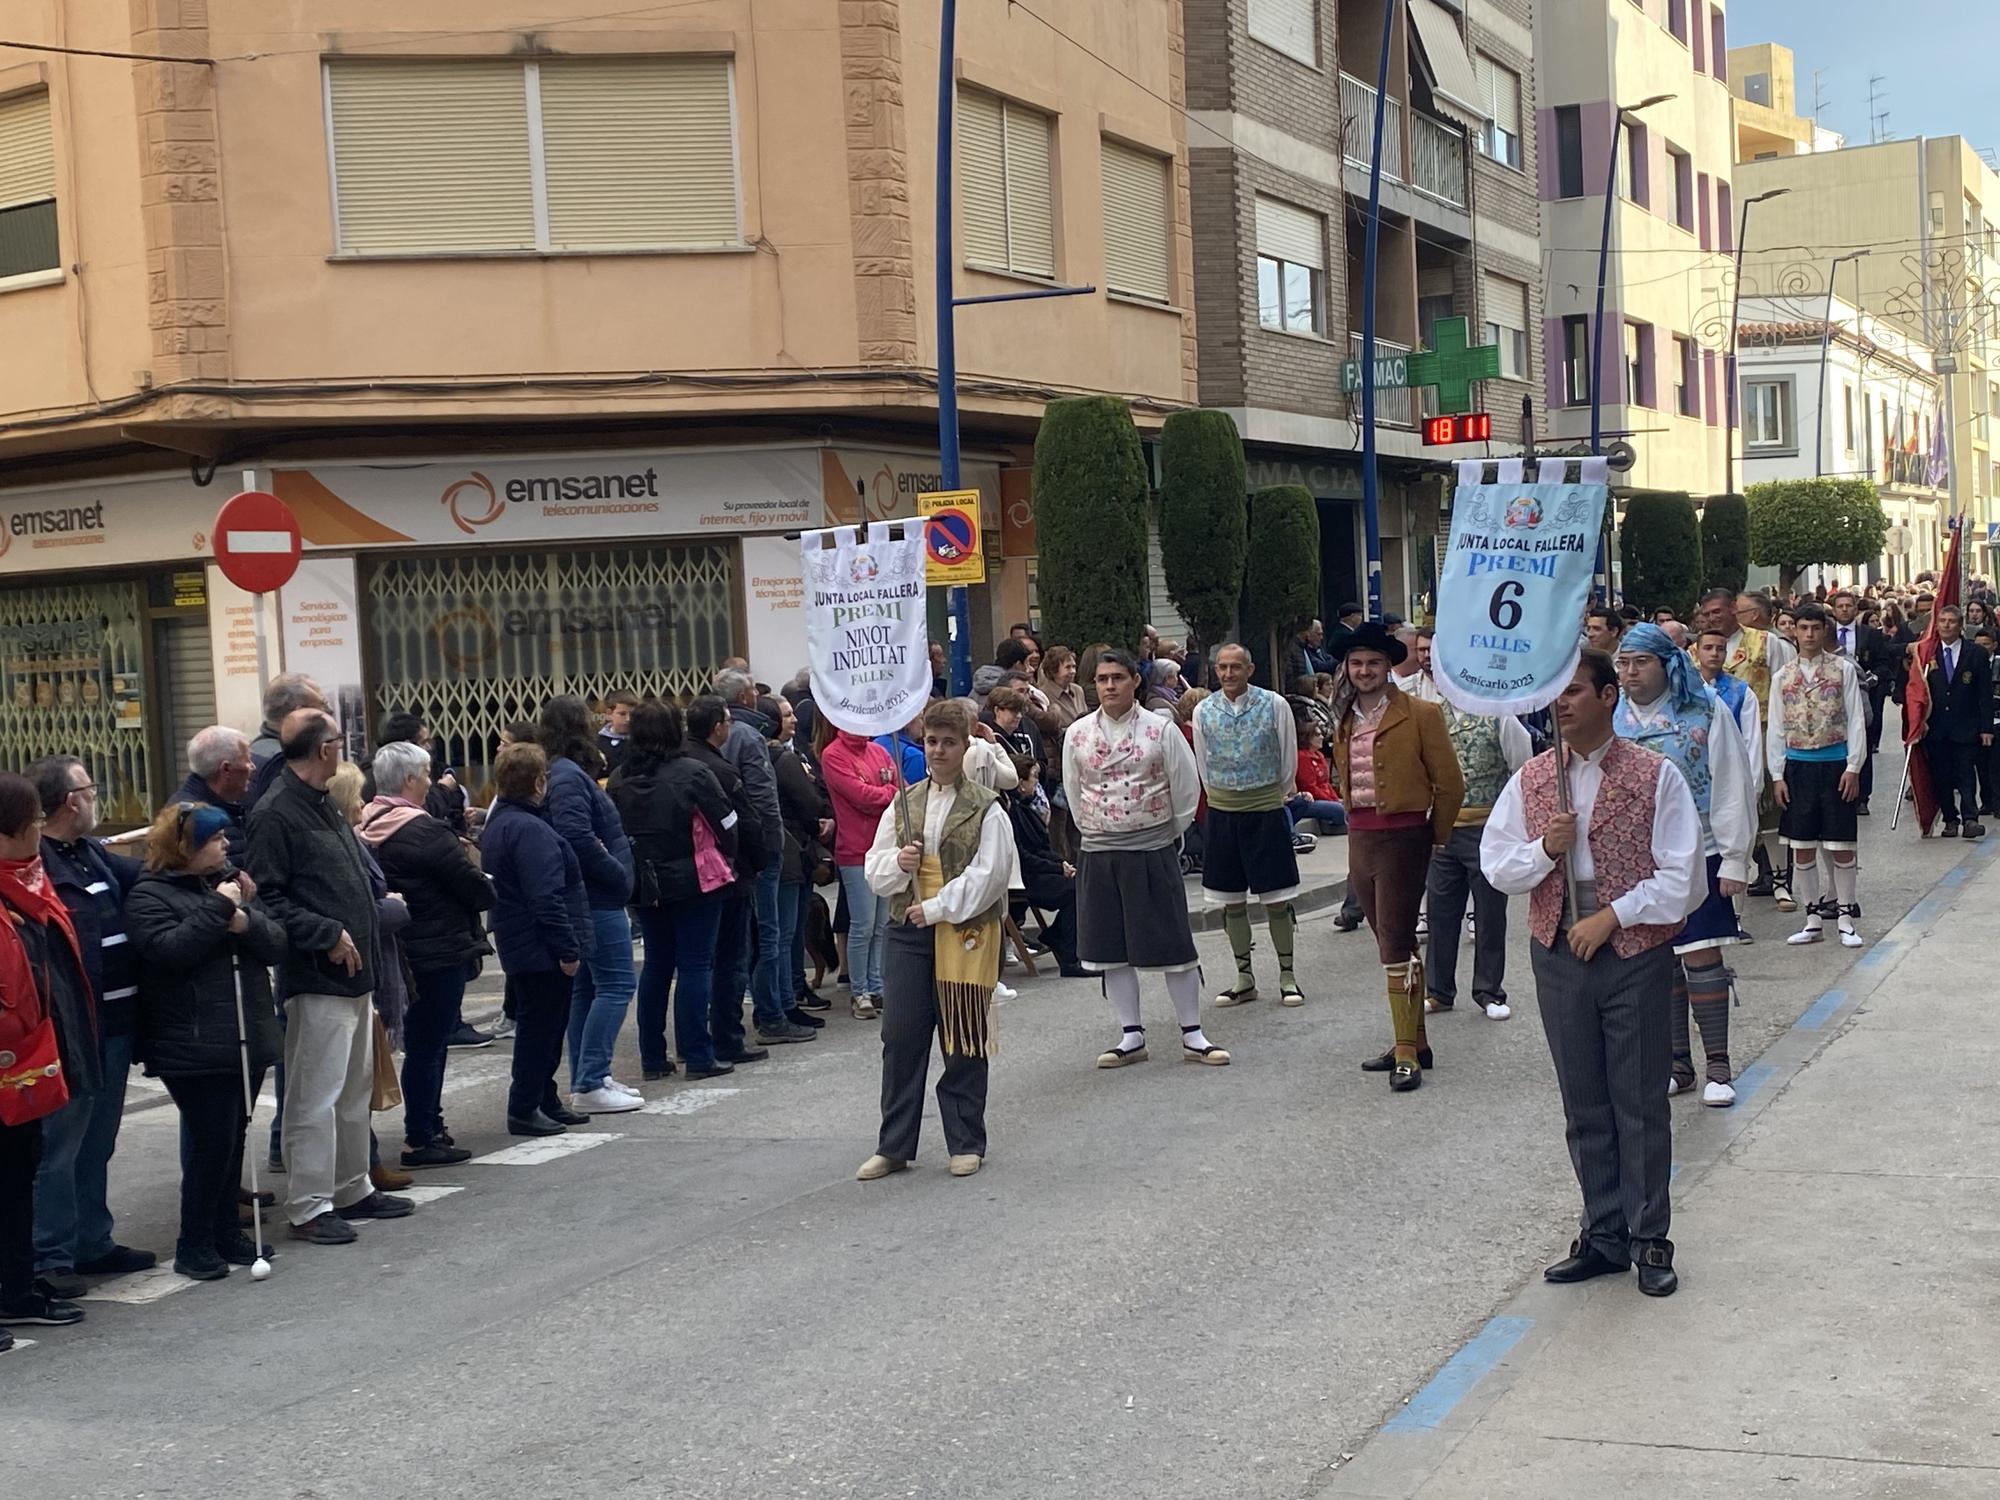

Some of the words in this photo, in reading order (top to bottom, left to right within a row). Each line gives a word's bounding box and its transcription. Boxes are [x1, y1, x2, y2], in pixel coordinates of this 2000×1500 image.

[505, 467, 658, 503] emsanet
[543, 502, 659, 517] telecomunicaciones
[735, 500, 777, 512] proveedor
[778, 499, 798, 509] local
[11, 500, 105, 536] emsanet
[1456, 533, 1489, 552] JUNTA
[1493, 537, 1531, 552] LOCAL
[1534, 533, 1585, 553] FALLERA
[1467, 552, 1560, 580] PREMI
[815, 591, 846, 607] JUNTA
[847, 589, 875, 604] LOCAL
[877, 581, 919, 600] FALLERA
[300, 601, 338, 612] Servicios
[832, 601, 905, 629] PREMI
[1489, 580, 1525, 631] 6
[309, 626, 331, 637] para
[845, 625, 892, 649] NINOT
[299, 637, 343, 649] empresas
[1469, 634, 1532, 654] FALLES
[832, 645, 908, 672] INDULTAT
[851, 669, 895, 686] FALLES
[1459, 667, 1509, 690] Benicarló
[1510, 673, 1535, 691] 2023
[885, 689, 910, 710] 2023
